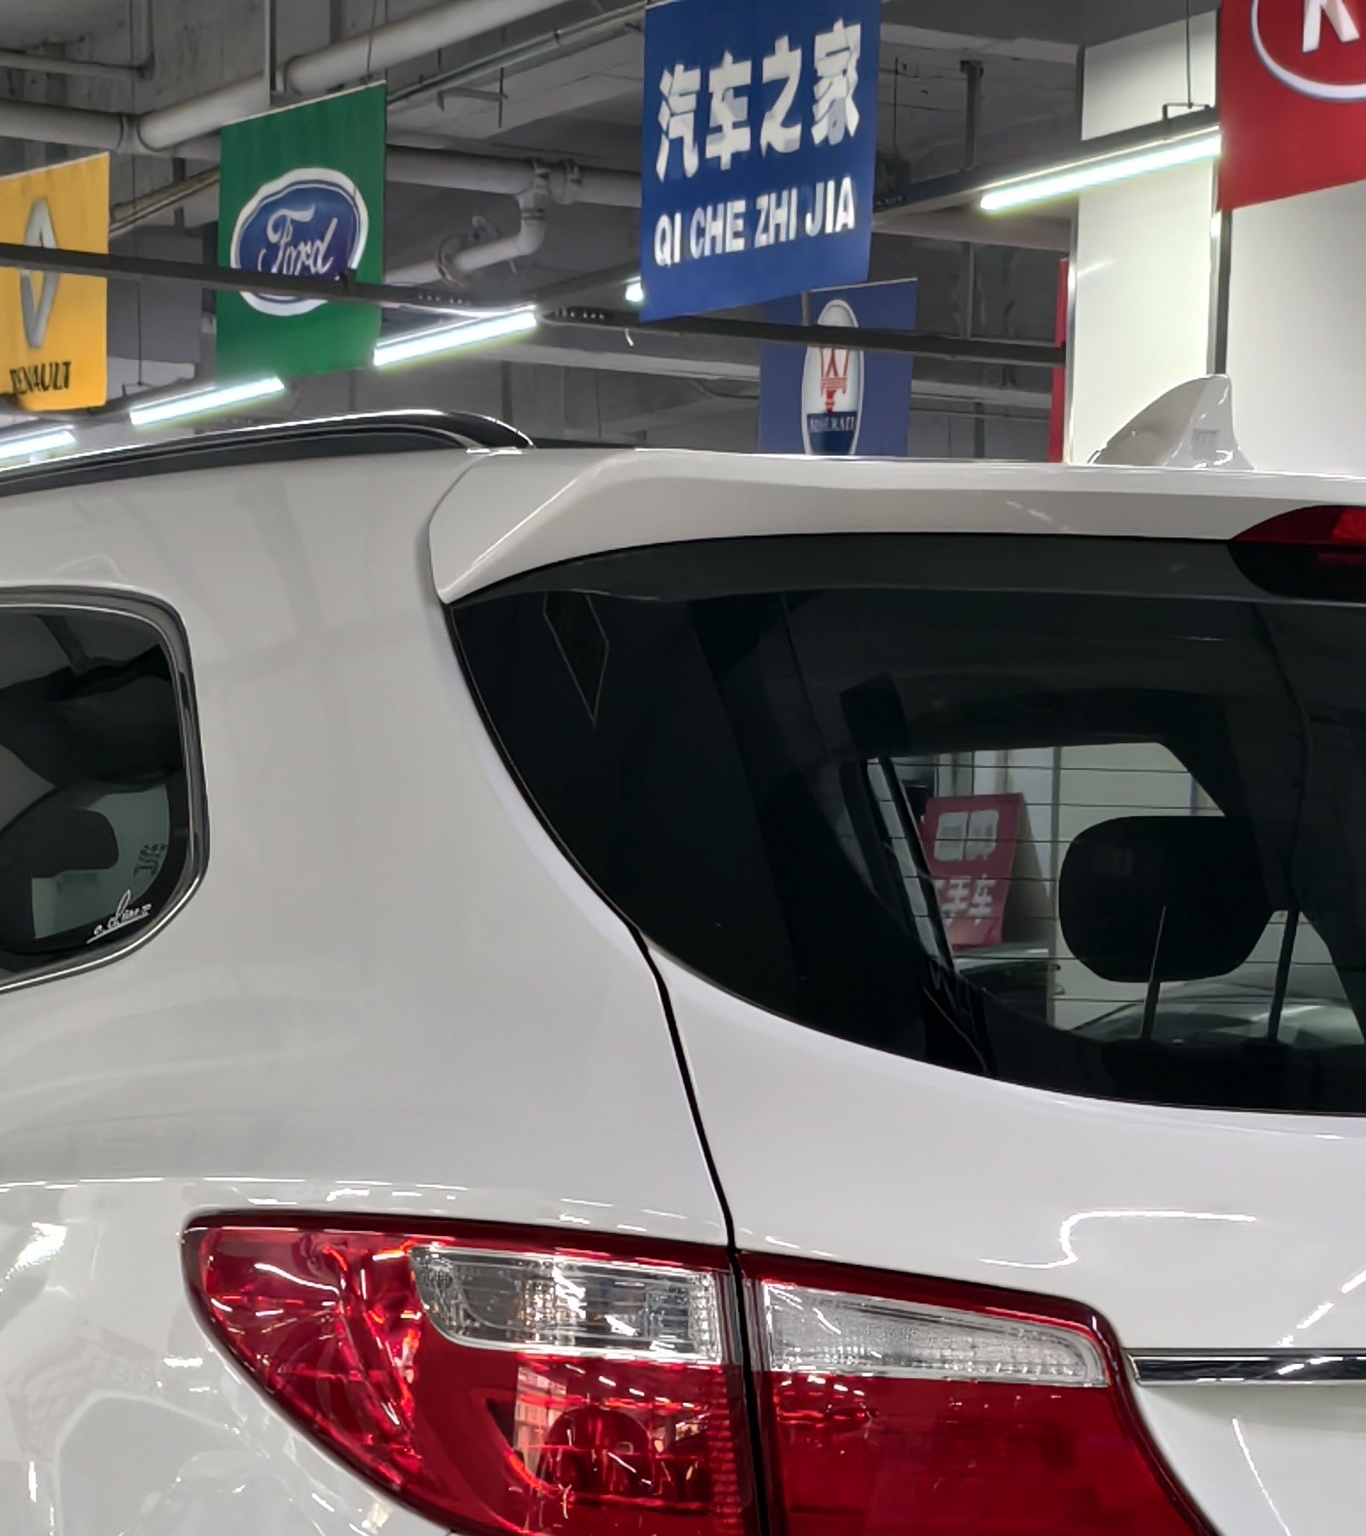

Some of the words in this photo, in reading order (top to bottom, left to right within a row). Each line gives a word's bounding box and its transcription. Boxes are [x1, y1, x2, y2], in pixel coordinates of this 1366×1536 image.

[656, 18, 861, 183] 汽车之家
[257, 204, 338, 277] Ford
[654, 211, 682, 267] QI
[690, 200, 746, 259] CHE
[754, 187, 797, 248] ZHI
[805, 176, 855, 237] JIA
